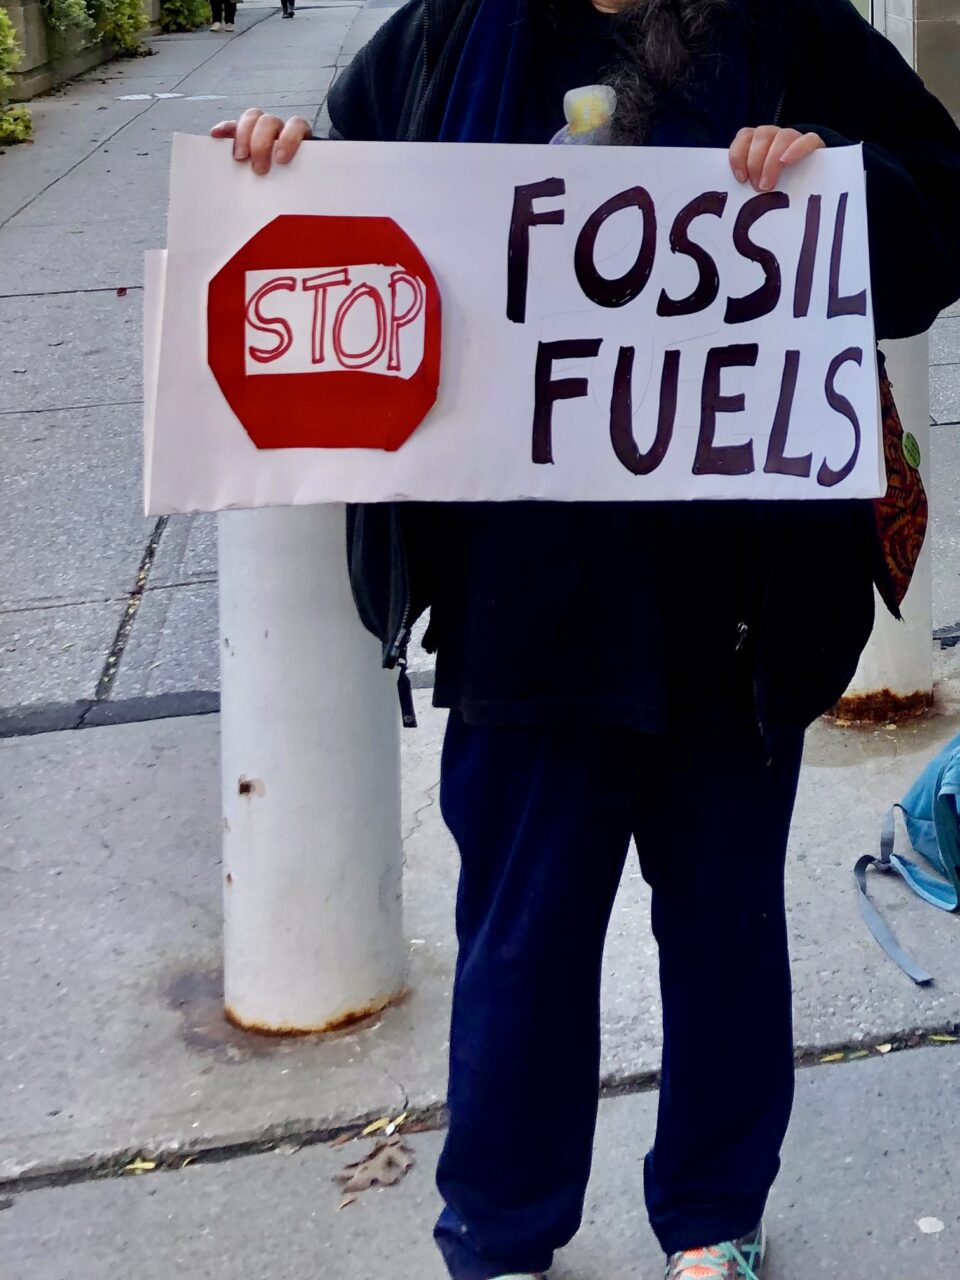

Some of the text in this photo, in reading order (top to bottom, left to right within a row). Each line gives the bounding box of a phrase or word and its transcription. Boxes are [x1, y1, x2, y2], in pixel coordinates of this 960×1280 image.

[246, 268, 424, 372] STOP
[506, 176, 867, 324] FOSSIL
[532, 338, 863, 488] FUELS
